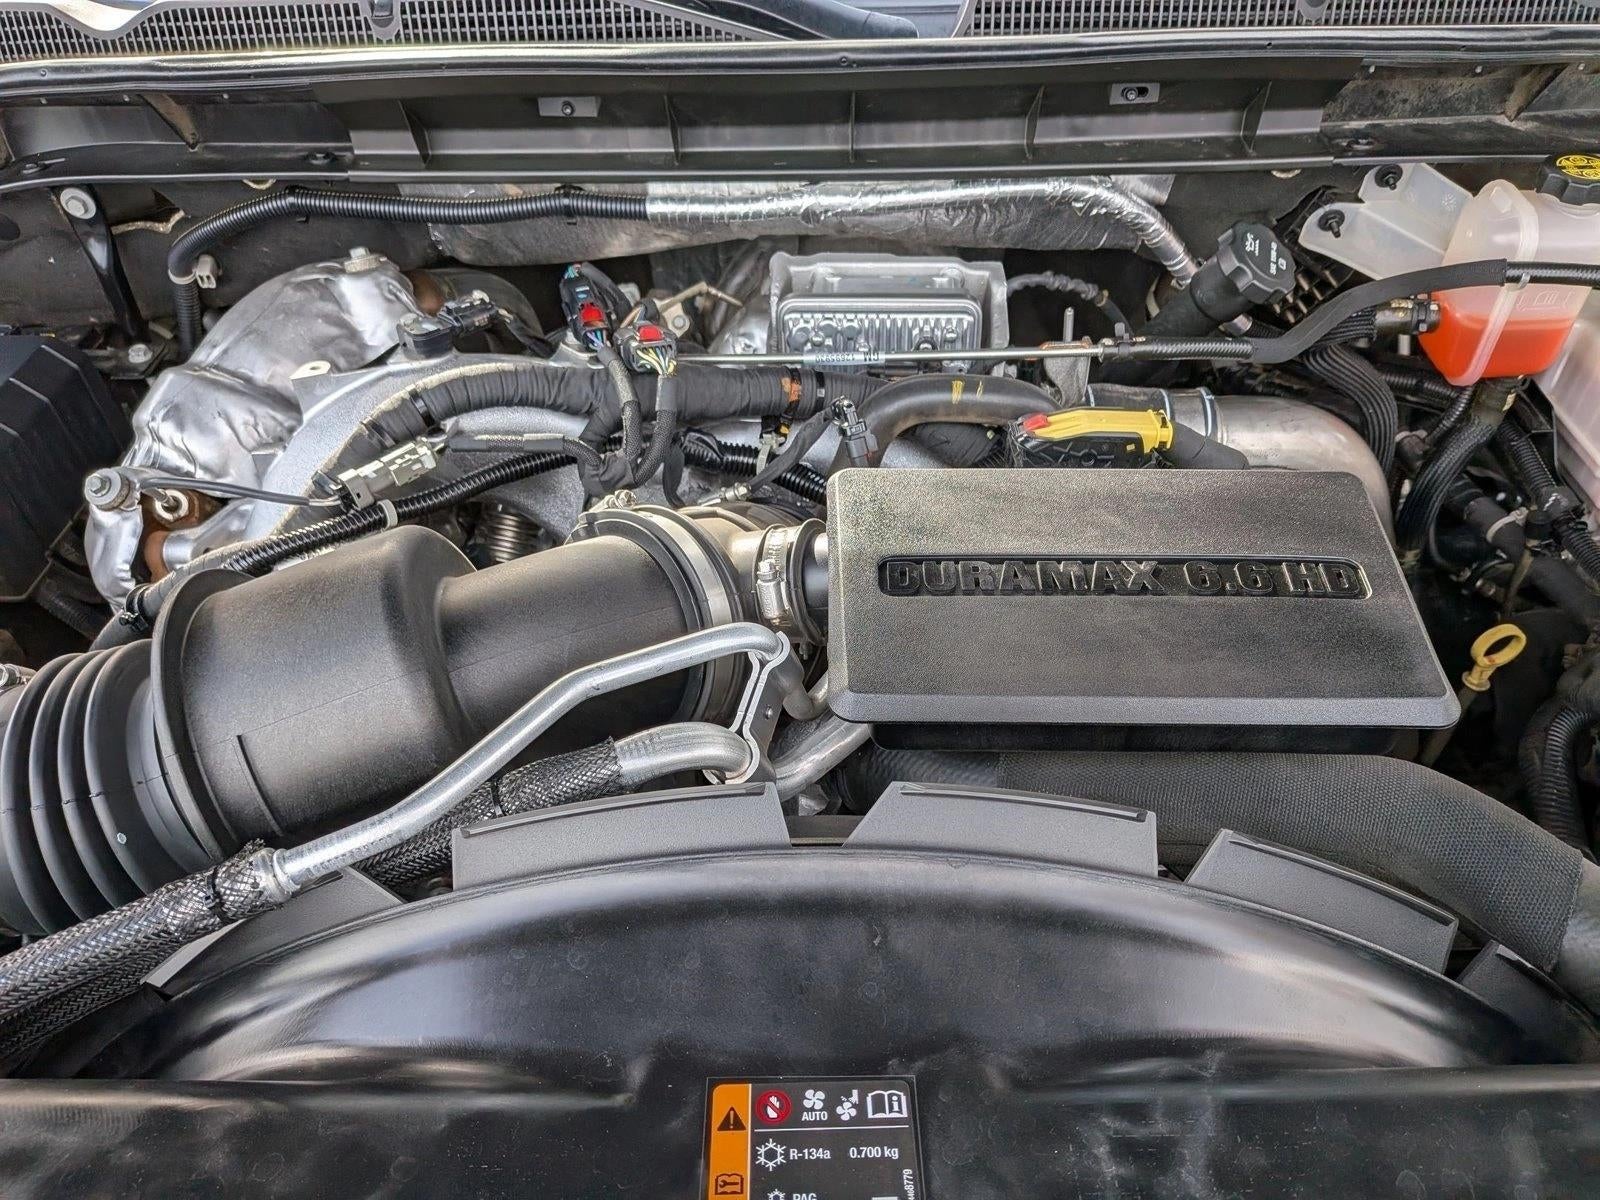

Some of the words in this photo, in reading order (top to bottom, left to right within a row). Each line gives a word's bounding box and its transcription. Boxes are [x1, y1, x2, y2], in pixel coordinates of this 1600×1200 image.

[885, 560, 1165, 595] DURAMAX
[1182, 560, 1274, 595] 6.6
[1280, 560, 1360, 596] HD
[801, 1111, 829, 1122] AUTO
[789, 1148, 832, 1160] R-134a
[849, 1146, 882, 1159] 0.700
[884, 1146, 899, 1160] kg
